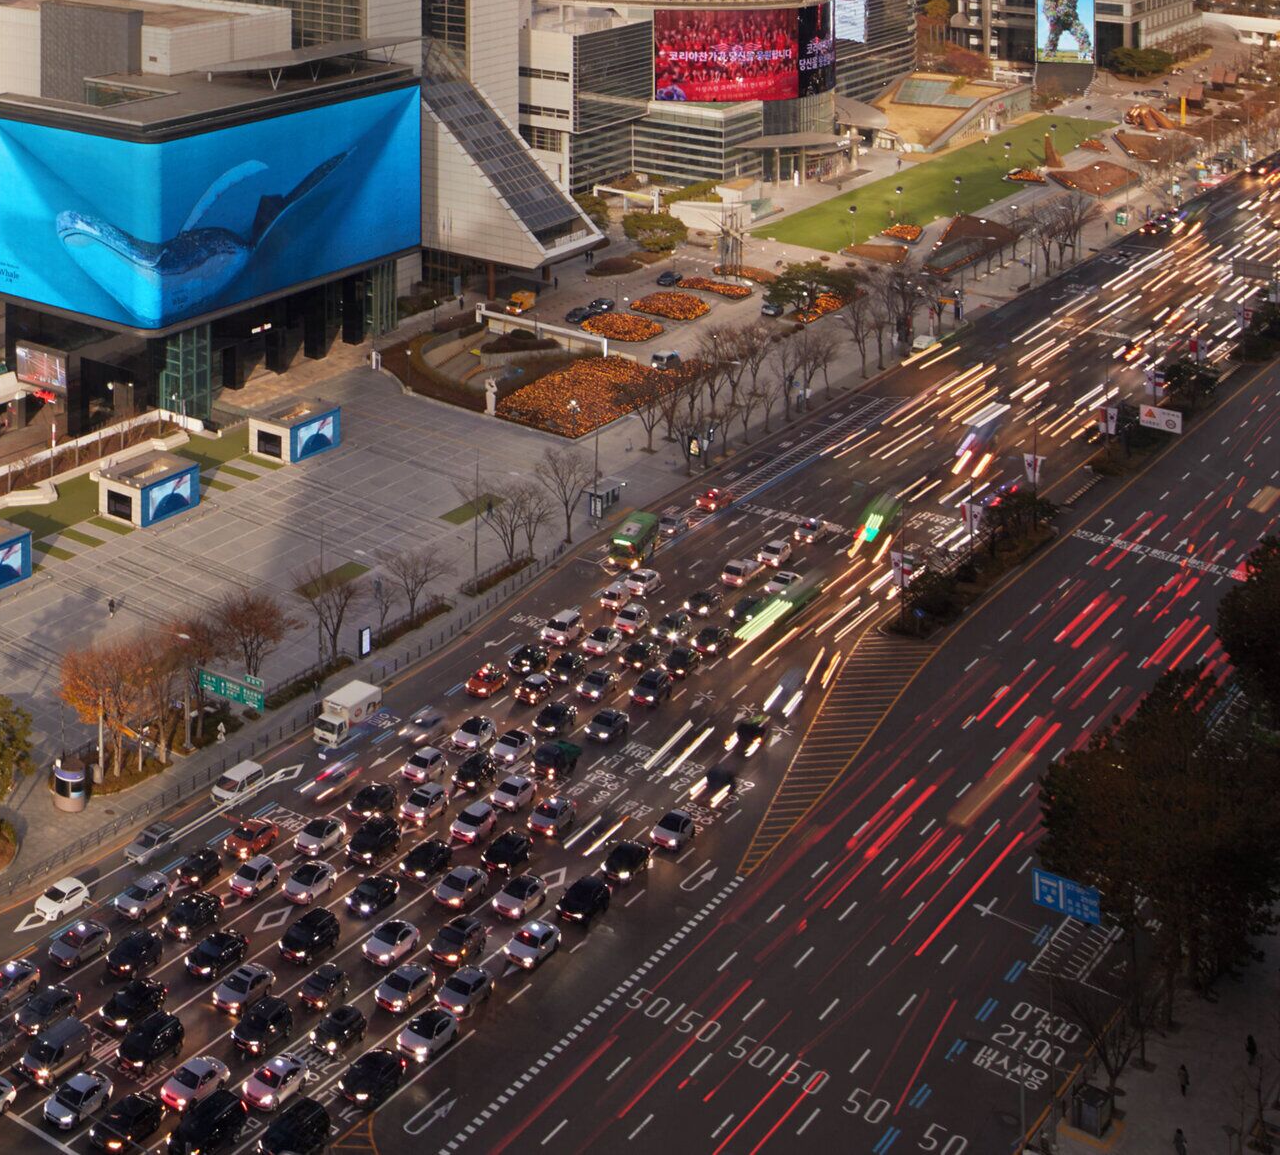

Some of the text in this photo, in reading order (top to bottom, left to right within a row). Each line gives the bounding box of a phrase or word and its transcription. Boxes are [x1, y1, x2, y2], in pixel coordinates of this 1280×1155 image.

[626, 988, 670, 1018] 50
[676, 1010, 721, 1042] 50
[728, 1035, 776, 1068] 50
[991, 1023, 1066, 1066] 21:00
[780, 1058, 830, 1094] 50
[842, 1088, 891, 1123] 50
[918, 1123, 968, 1155] 50
